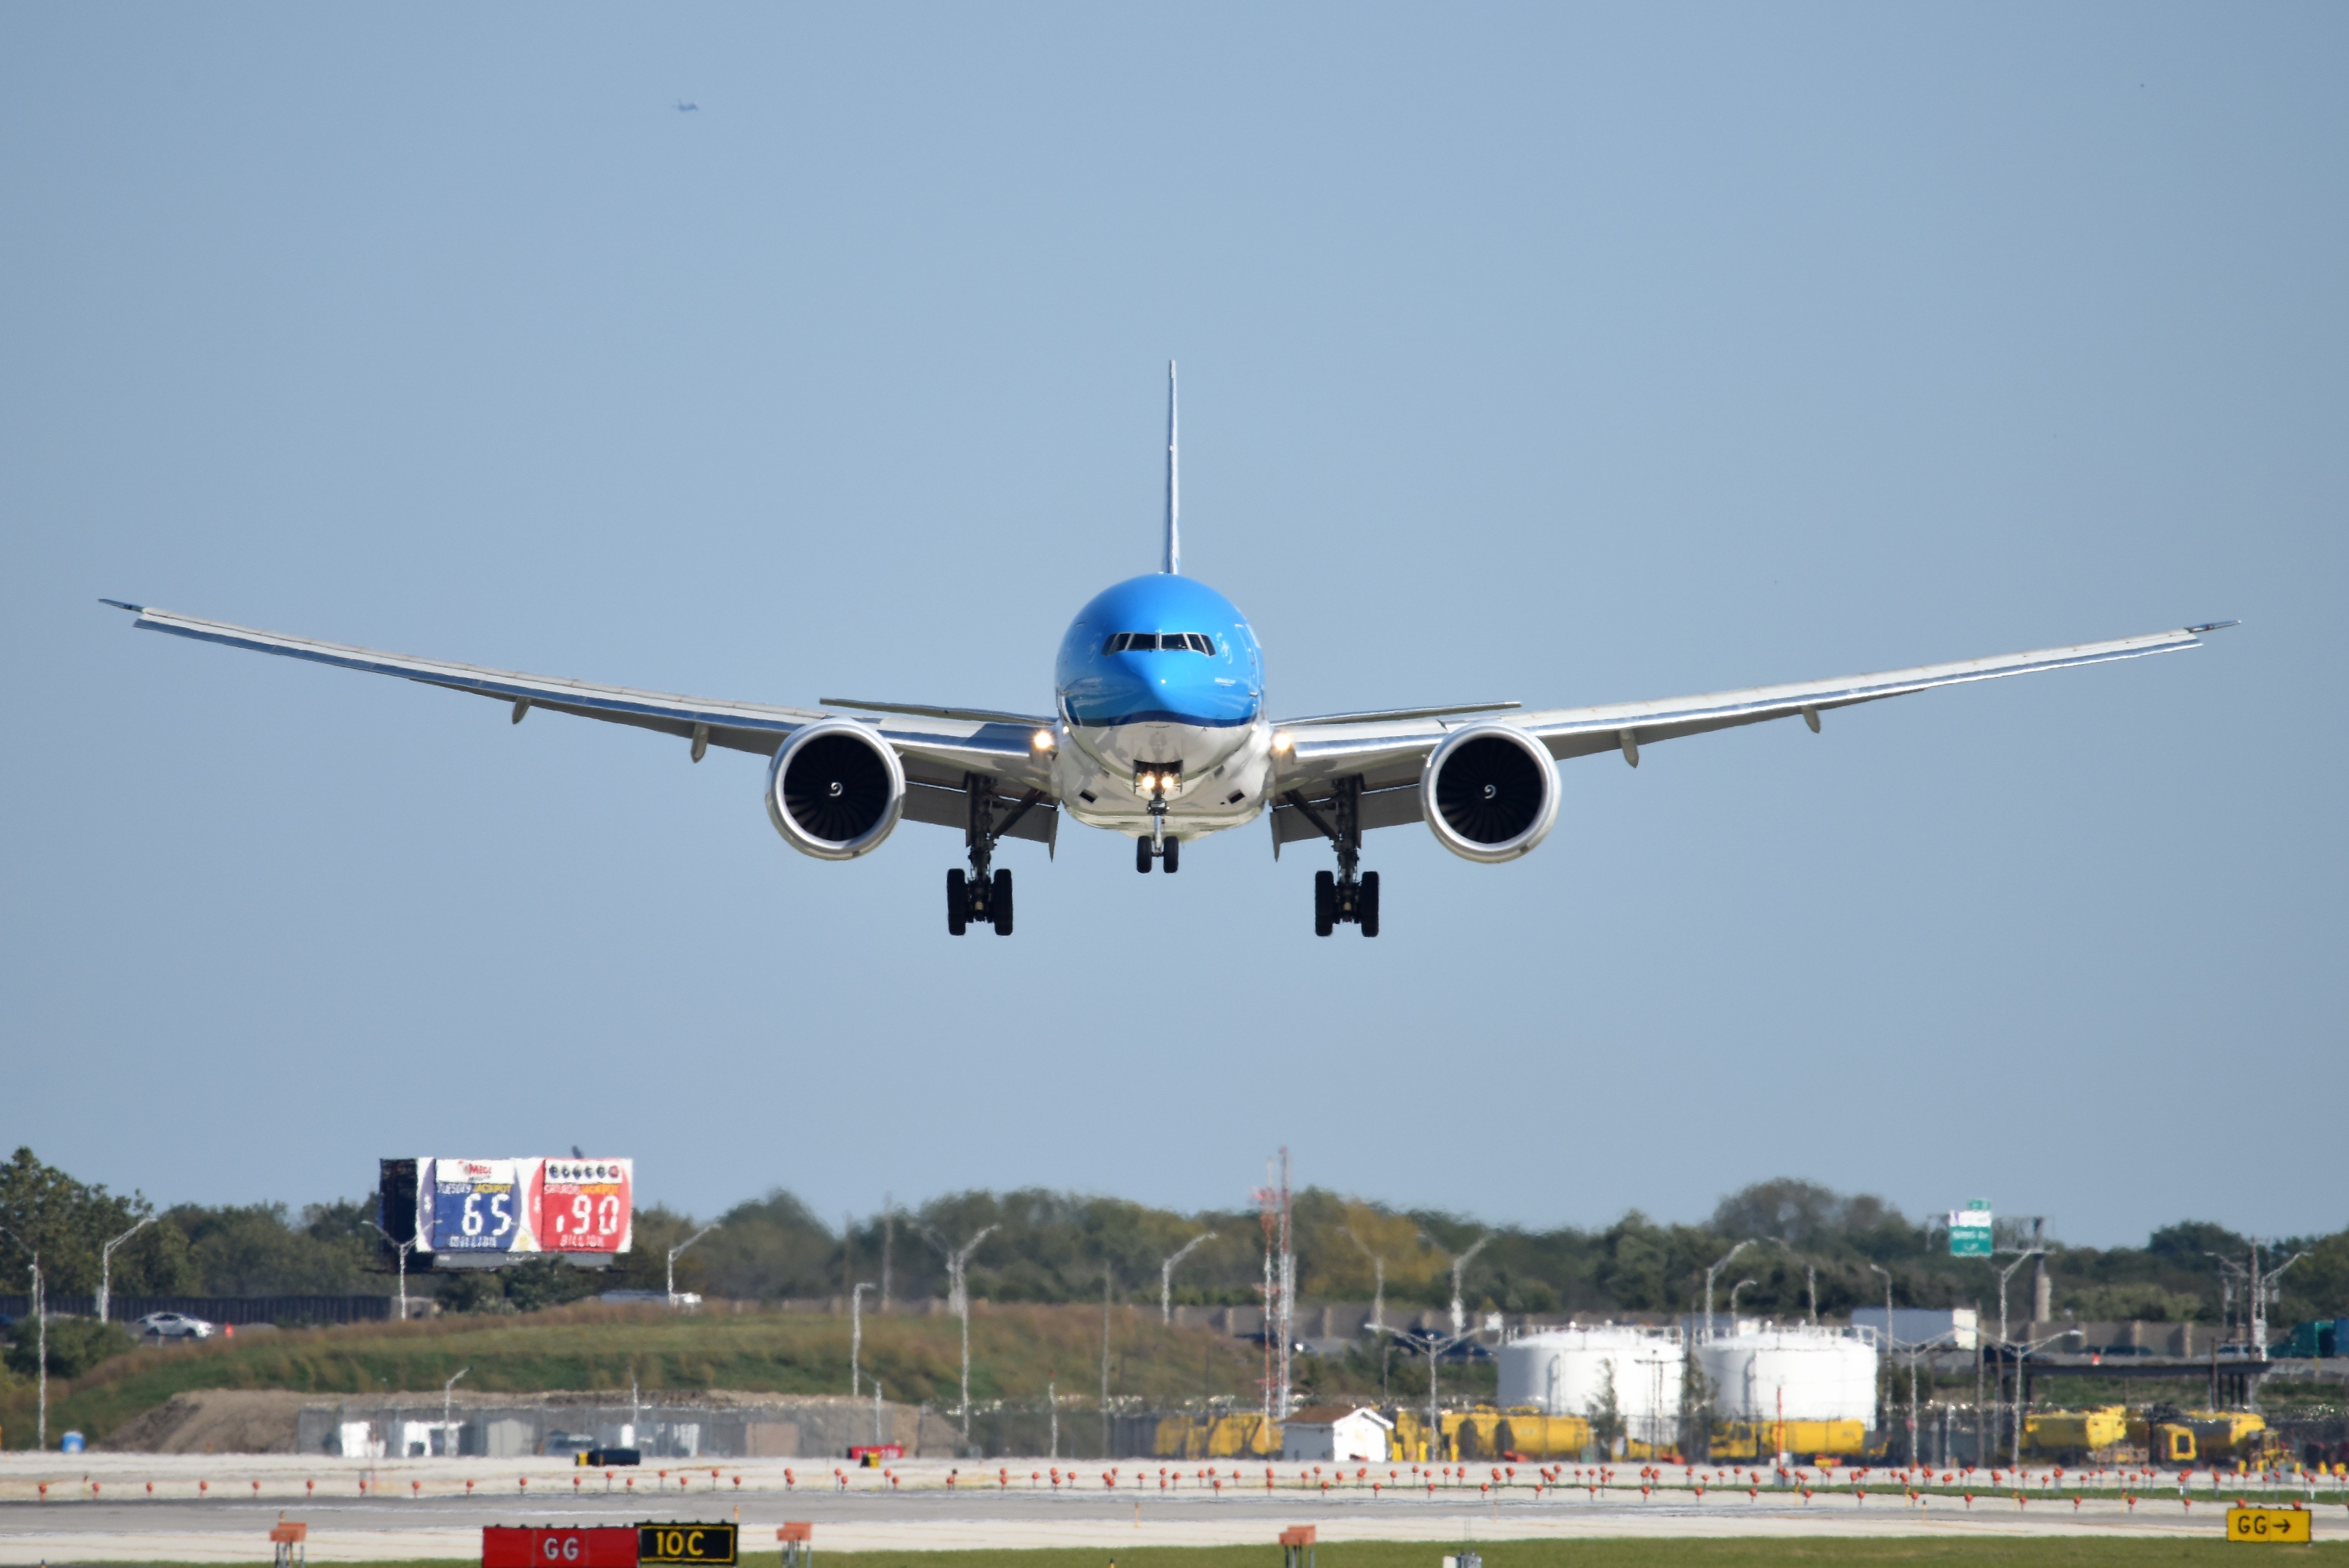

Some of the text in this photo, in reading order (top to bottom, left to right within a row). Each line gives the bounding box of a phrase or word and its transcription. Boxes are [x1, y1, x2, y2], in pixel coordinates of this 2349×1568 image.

[462, 1194, 512, 1236] 65
[2238, 1515, 2267, 1535] GG
[543, 1537, 579, 1561] GG
[656, 1531, 704, 1555] 10C
